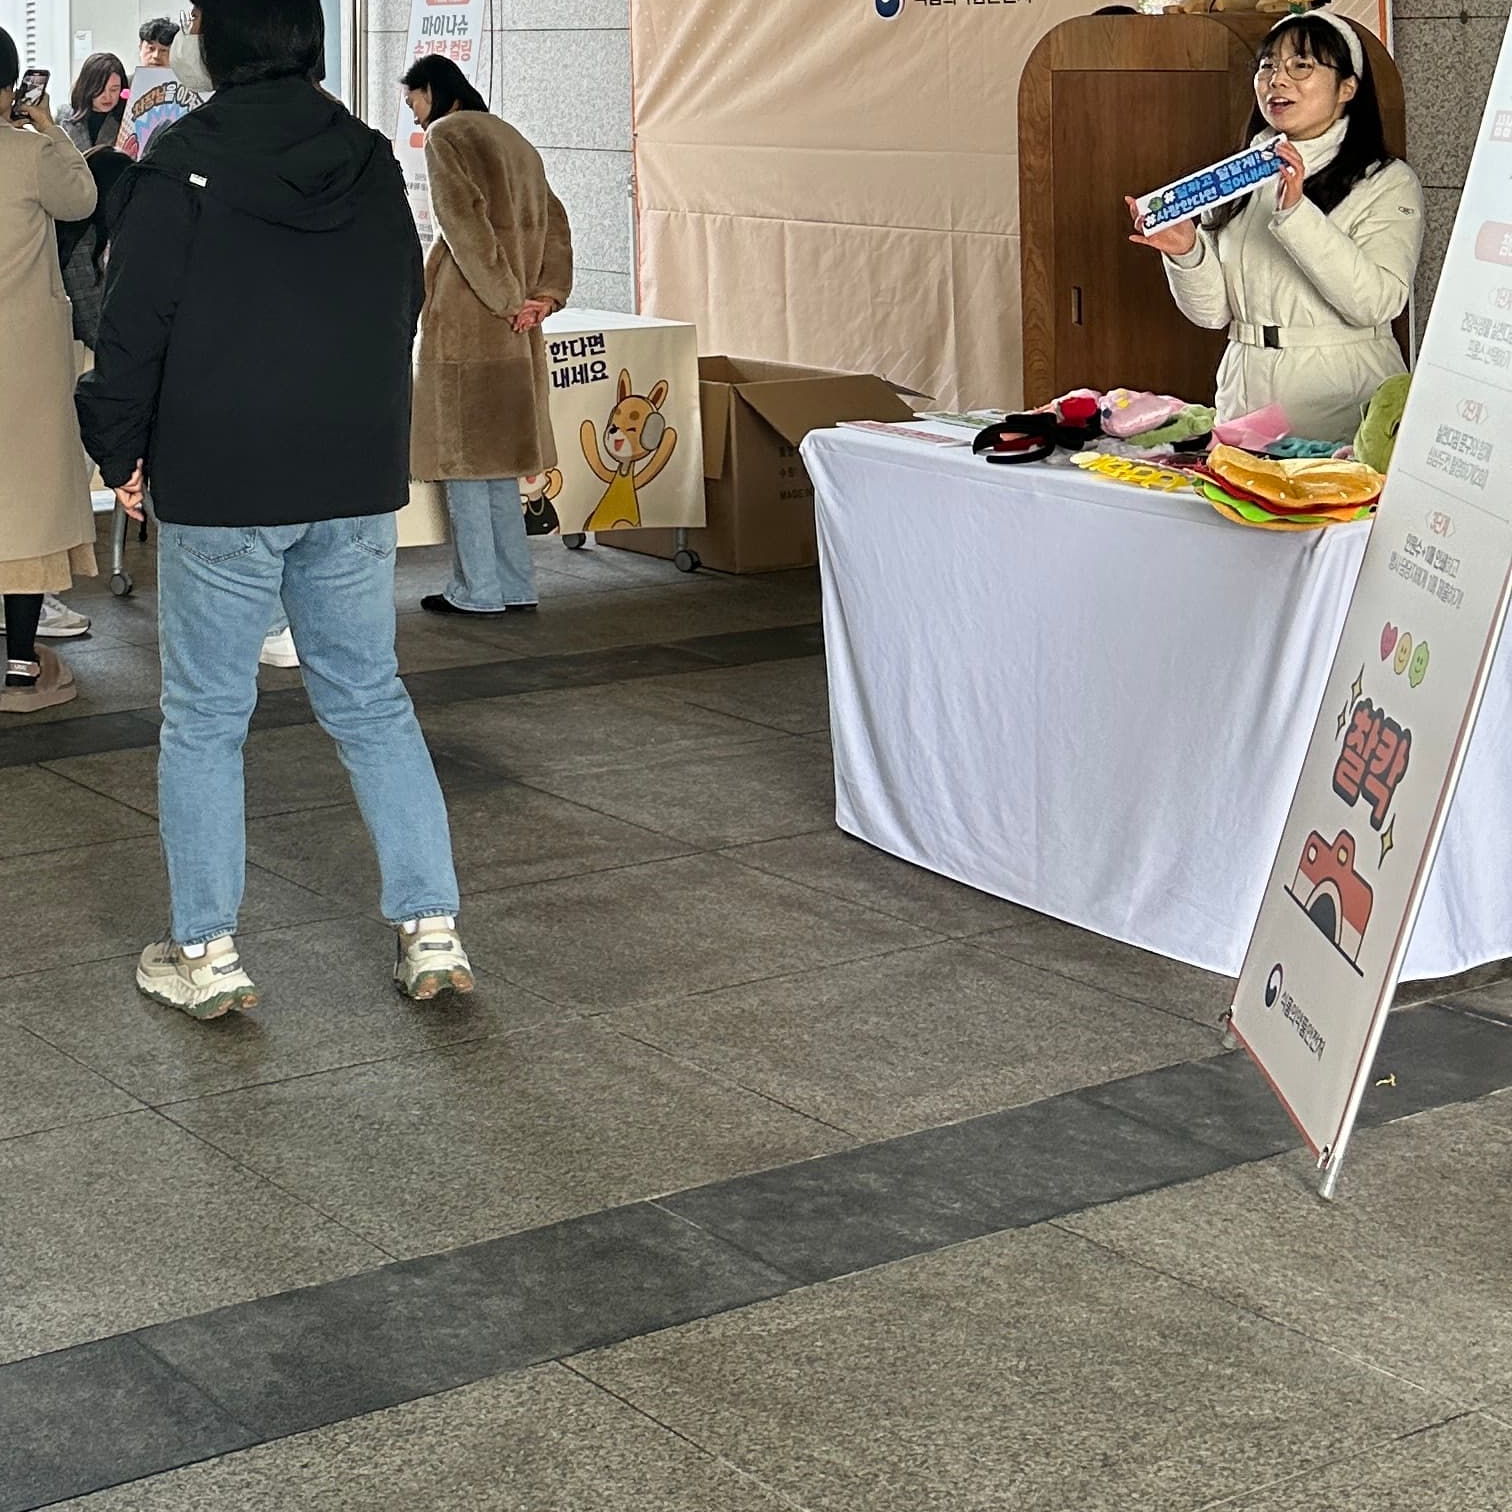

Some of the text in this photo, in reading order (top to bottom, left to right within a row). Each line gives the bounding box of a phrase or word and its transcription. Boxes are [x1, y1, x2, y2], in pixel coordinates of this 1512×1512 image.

[422, 14, 469, 36] 마이나슈
[449, 39, 473, 62] 컬링
[549, 333, 606, 363] 한다면
[551, 360, 609, 388] 내세요
[1334, 698, 1411, 830] 찰칵
[1281, 991, 1326, 1062] 식품의약품안전처
